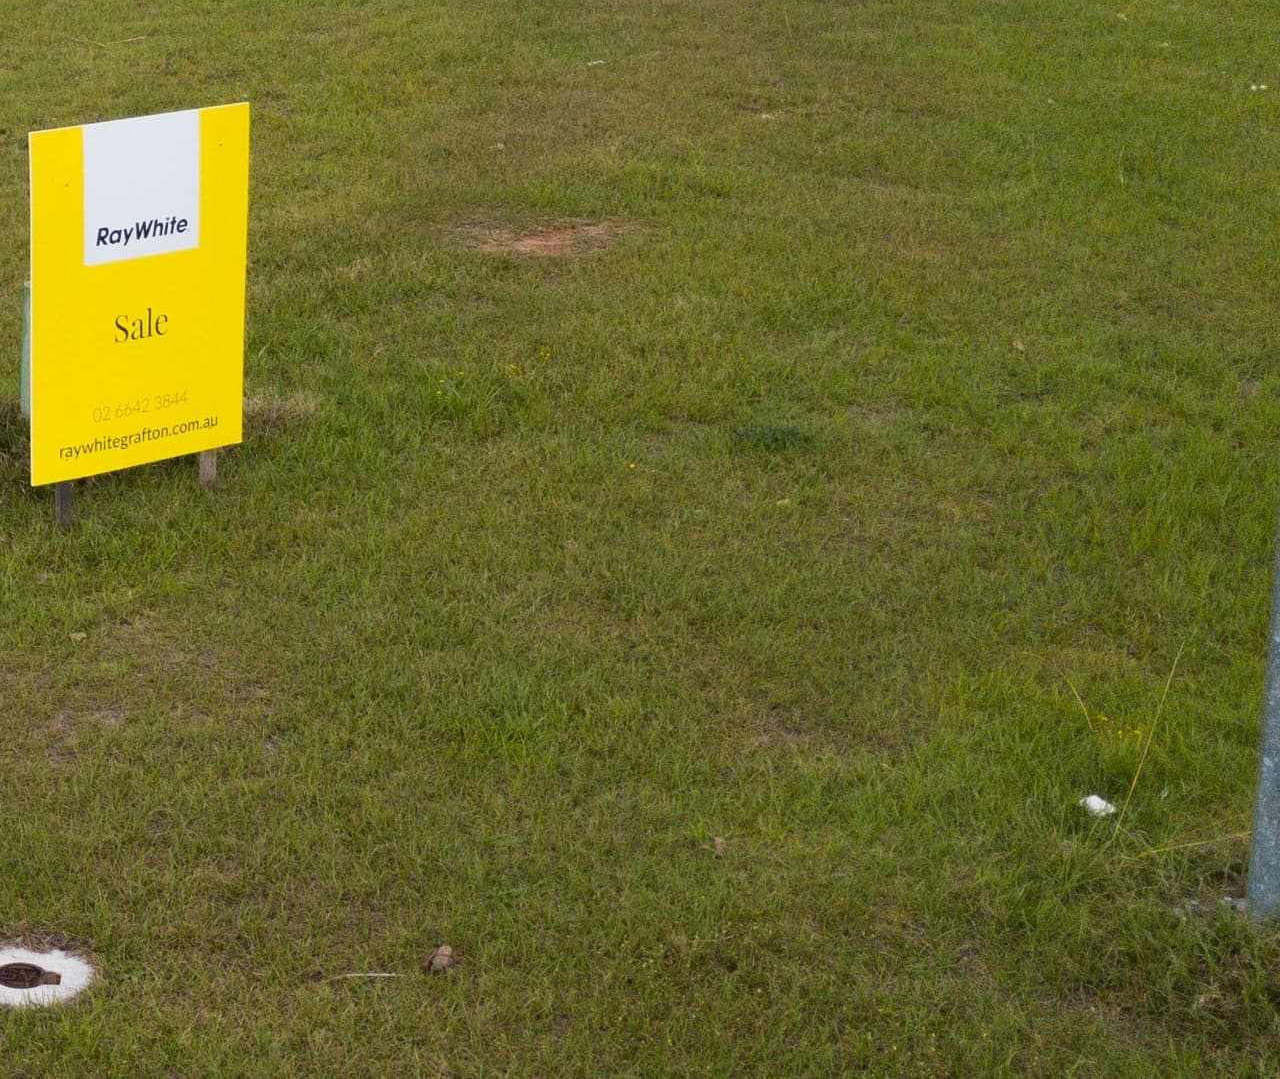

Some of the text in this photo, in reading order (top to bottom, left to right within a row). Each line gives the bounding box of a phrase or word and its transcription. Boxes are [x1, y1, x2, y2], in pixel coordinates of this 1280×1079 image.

[114, 307, 169, 343] Sale
[92, 390, 188, 423] 02 6642 3844
[59, 415, 218, 459] raywhitegrafton.com.au
